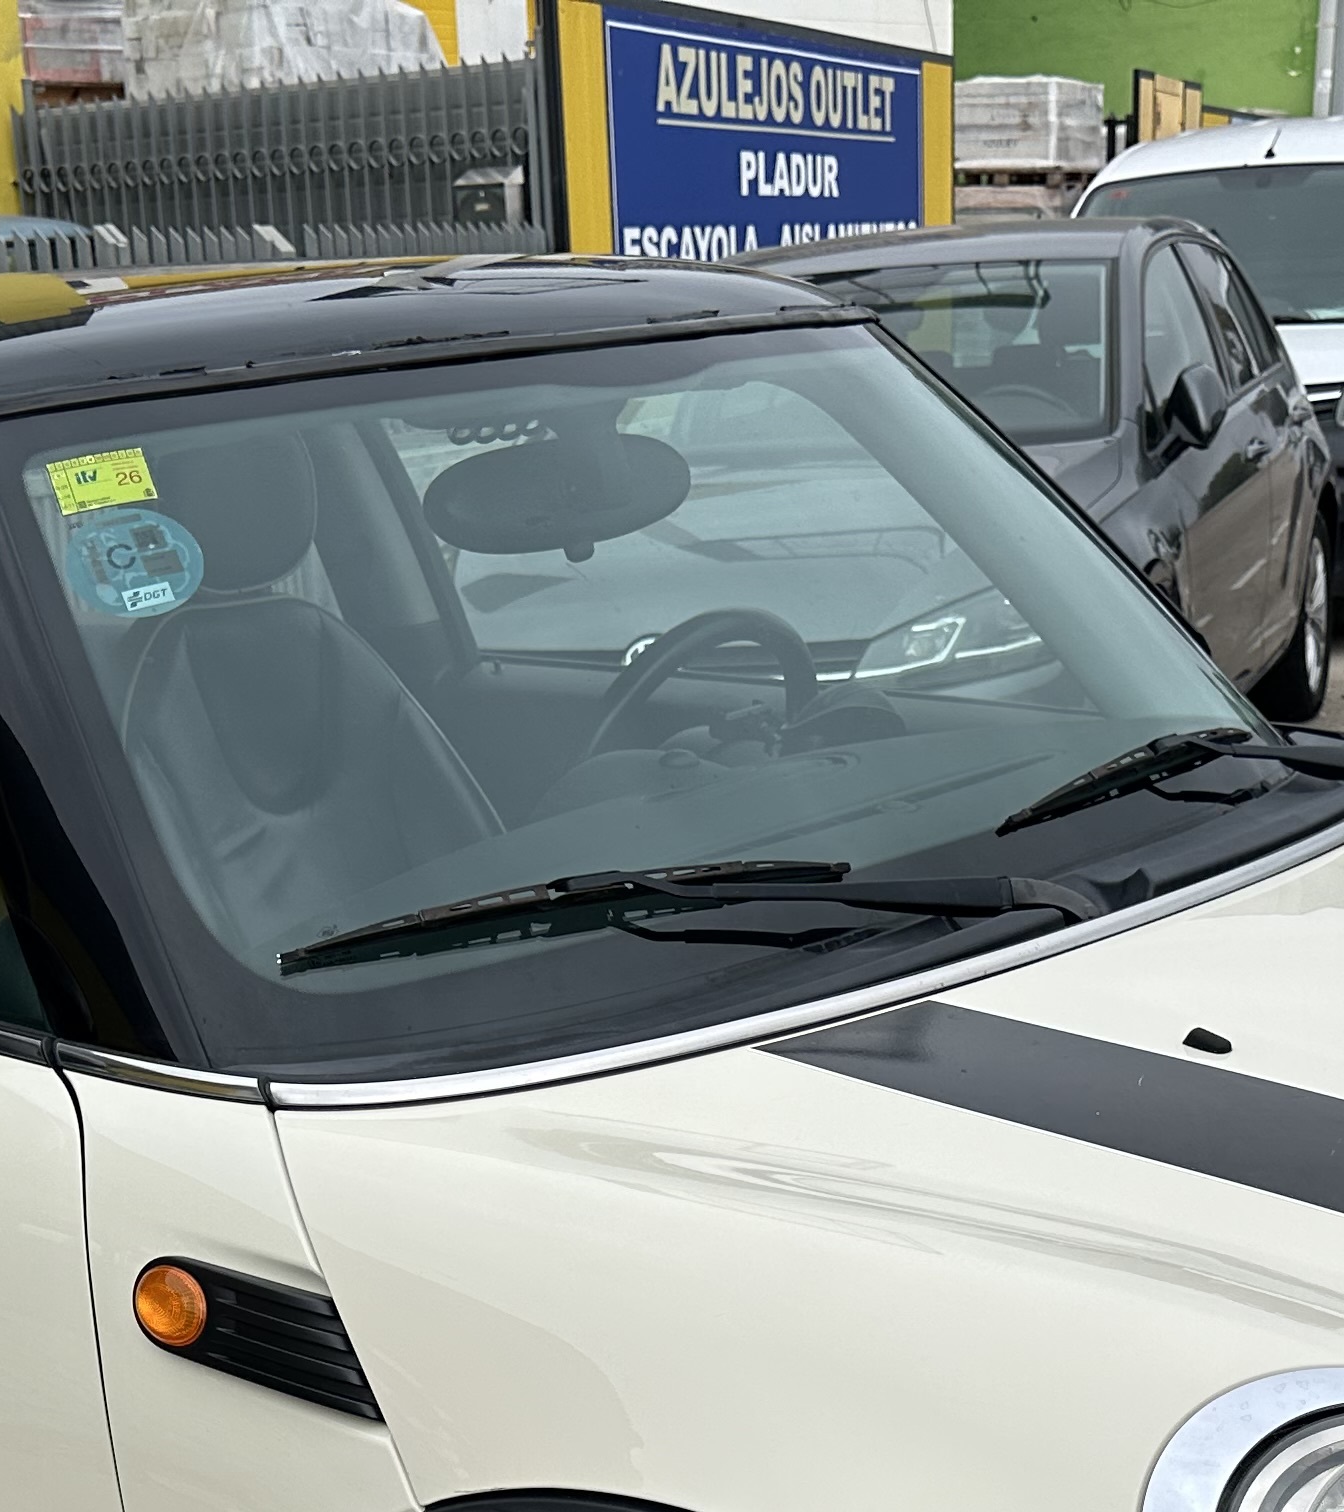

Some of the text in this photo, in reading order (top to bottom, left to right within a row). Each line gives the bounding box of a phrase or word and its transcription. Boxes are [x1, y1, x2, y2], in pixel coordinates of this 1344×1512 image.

[657, 43, 896, 132] AZULEJOS OUTLET
[739, 150, 840, 198] PLADUR
[623, 223, 758, 262] ESCAYOLA
[116, 470, 143, 487] 26
[107, 543, 136, 570] C
[144, 588, 167, 602] DGT
